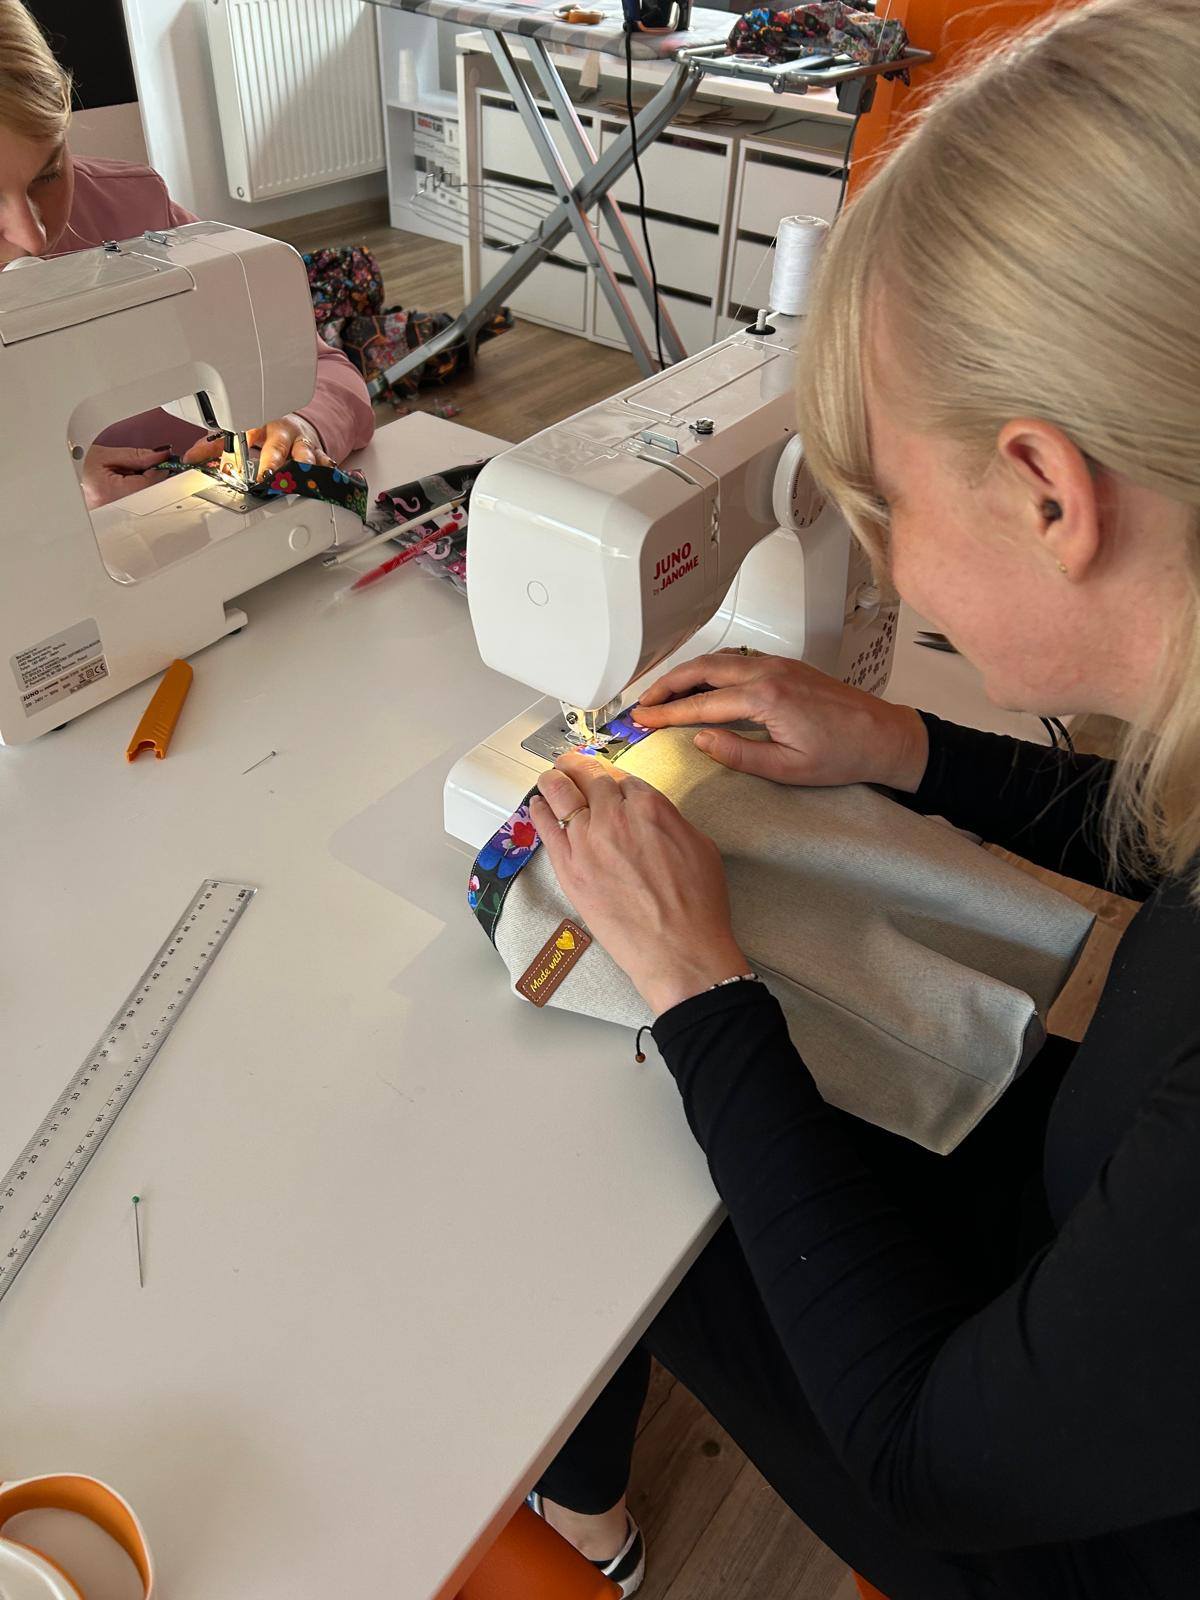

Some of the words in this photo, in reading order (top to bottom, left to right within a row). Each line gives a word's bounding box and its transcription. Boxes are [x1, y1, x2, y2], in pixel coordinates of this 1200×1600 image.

[653, 542, 692, 580] JUNO
[660, 555, 699, 591] JANOME
[23, 690, 40, 701] JUNO
[530, 968, 551, 993] Made
[549, 949, 565, 970] with
